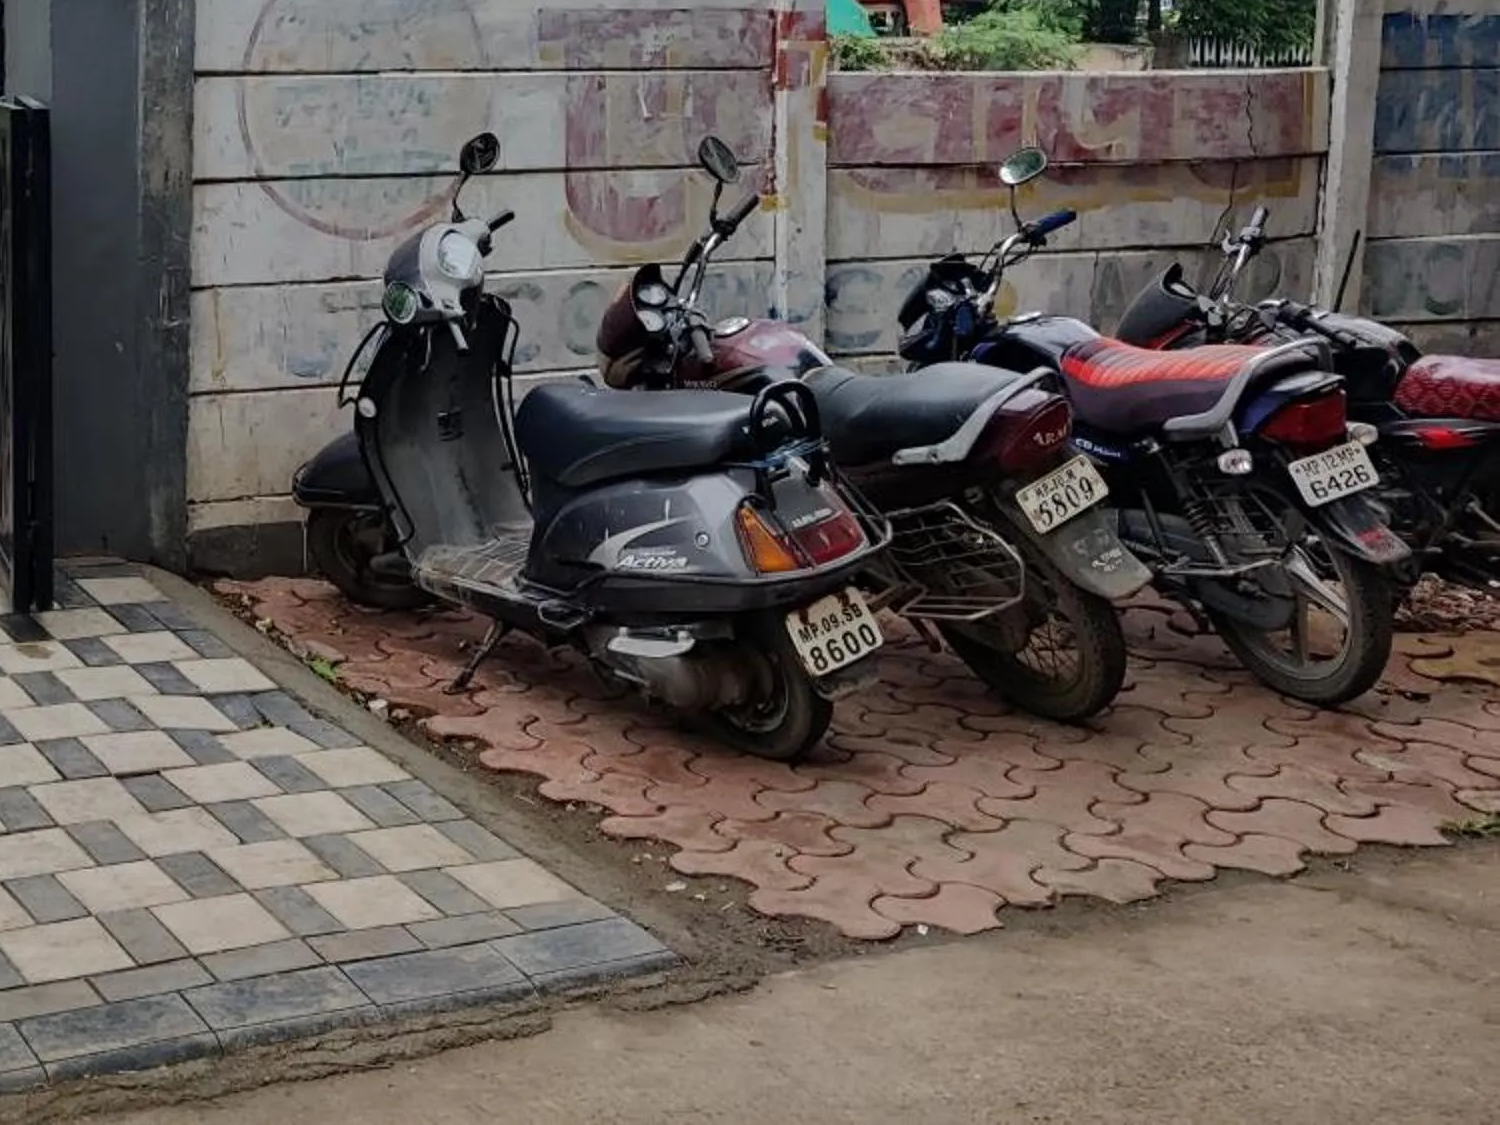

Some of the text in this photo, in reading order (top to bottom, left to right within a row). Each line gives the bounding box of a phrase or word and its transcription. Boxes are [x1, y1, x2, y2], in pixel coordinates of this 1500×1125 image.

[1038, 476, 1095, 527] 5809
[1310, 464, 1371, 499] 6426
[809, 623, 877, 672] 8600
